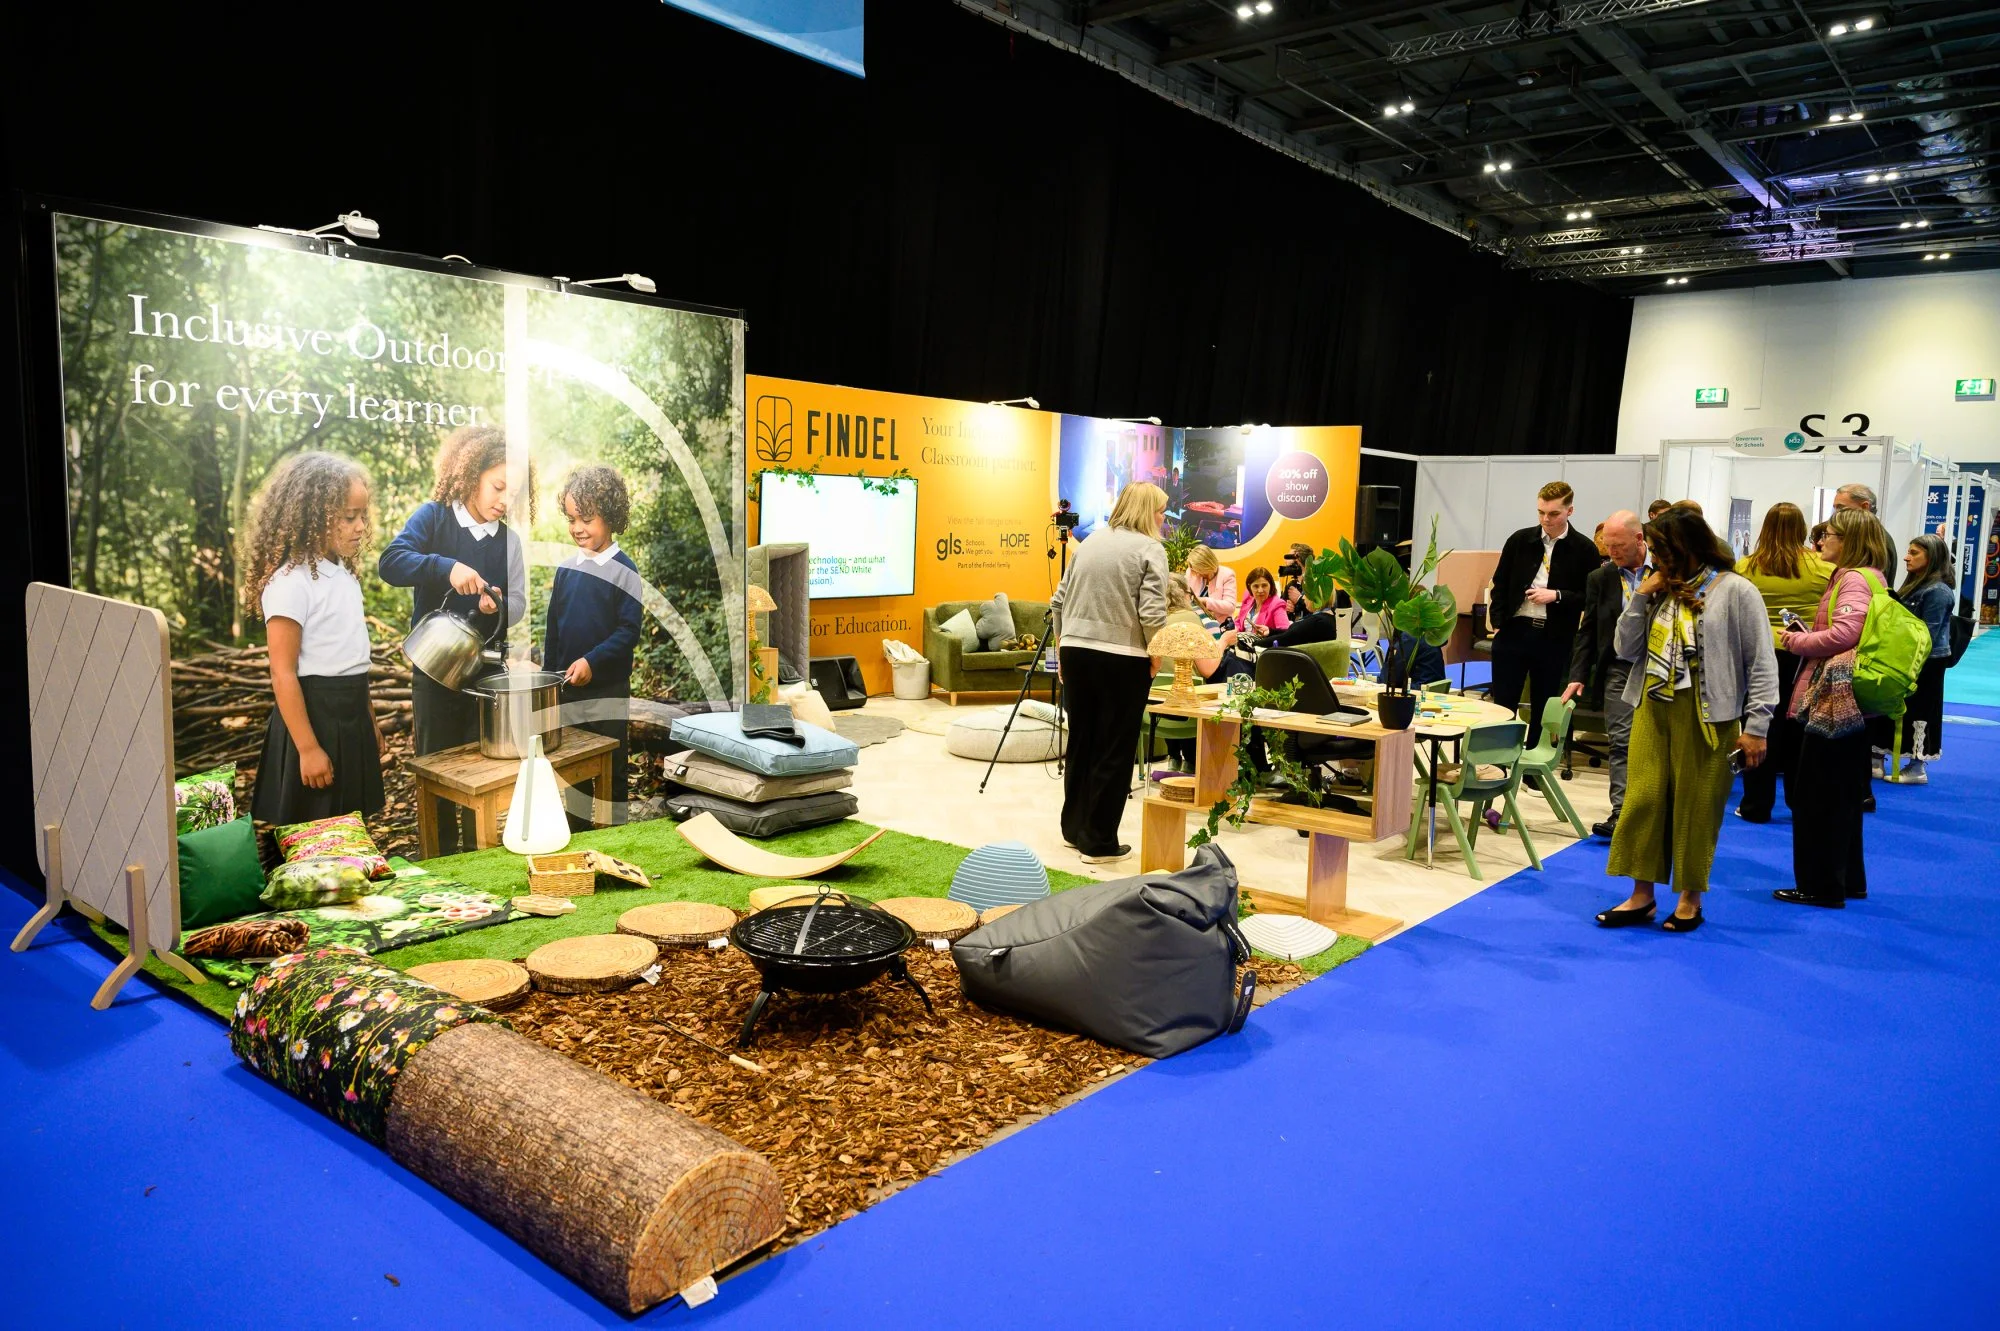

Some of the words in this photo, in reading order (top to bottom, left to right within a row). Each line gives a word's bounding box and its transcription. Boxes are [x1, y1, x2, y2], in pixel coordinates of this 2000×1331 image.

[127, 294, 332, 355] Inclusive
[130, 364, 201, 407] for
[216, 384, 334, 428] every
[347, 383, 487, 428] learner.
[921, 416, 954, 436] Your
[807, 410, 899, 461] FINDEL
[921, 446, 988, 468] Classroom
[992, 456, 1036, 474] partner.
[1303, 468, 1318, 479] off
[1285, 480, 1309, 491] show
[1277, 491, 1317, 503] discount
[936, 532, 965, 561] gls.
[1000, 533, 1030, 548] HOPE
[808, 555, 847, 566] echnology
[853, 556, 867, 564] and
[868, 555, 886, 564] what
[816, 566, 829, 574] the
[830, 565, 850, 575] SEND
[851, 565, 872, 574] White
[809, 575, 835, 586] usion).
[809, 617, 830, 637] for
[835, 614, 911, 635] Education.
